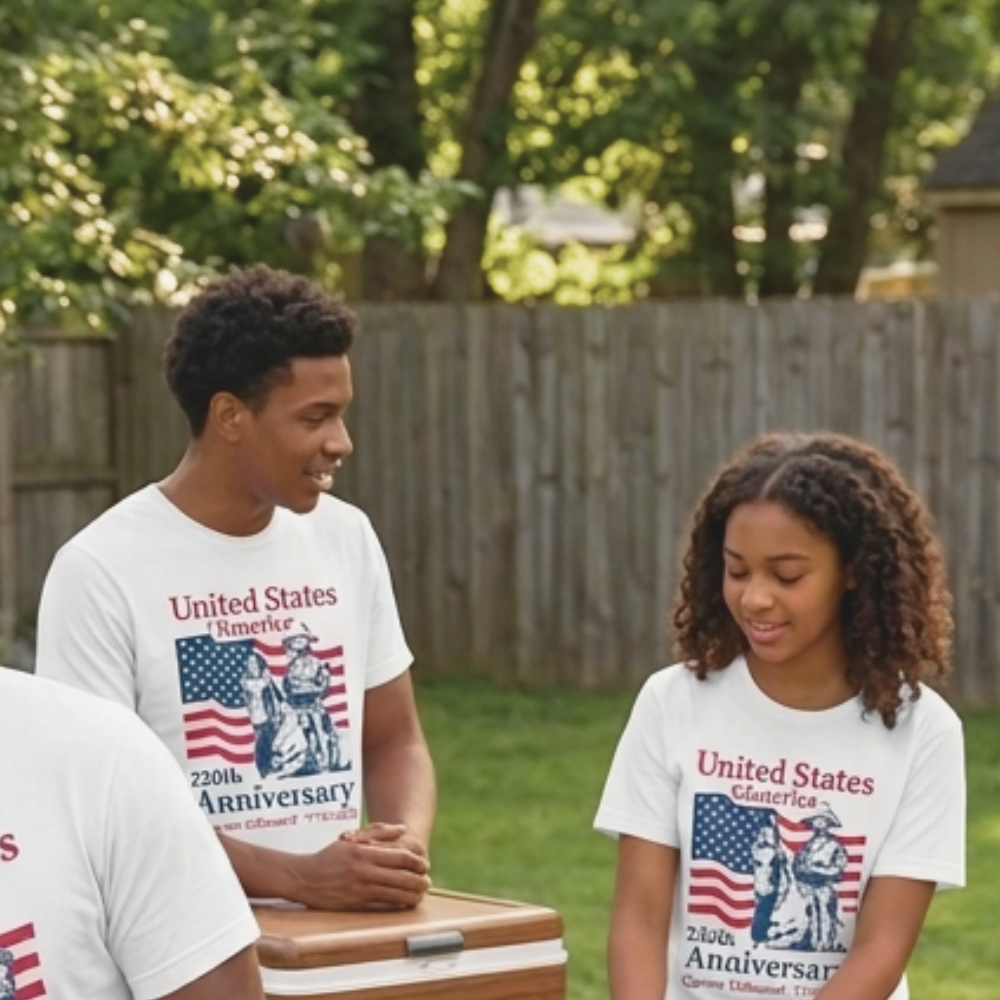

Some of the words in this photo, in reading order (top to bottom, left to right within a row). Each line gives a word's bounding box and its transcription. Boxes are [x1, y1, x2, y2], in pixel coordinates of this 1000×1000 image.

[168, 587, 260, 622] United
[264, 585, 338, 611] States
[697, 749, 787, 786] United
[792, 762, 875, 796] States
